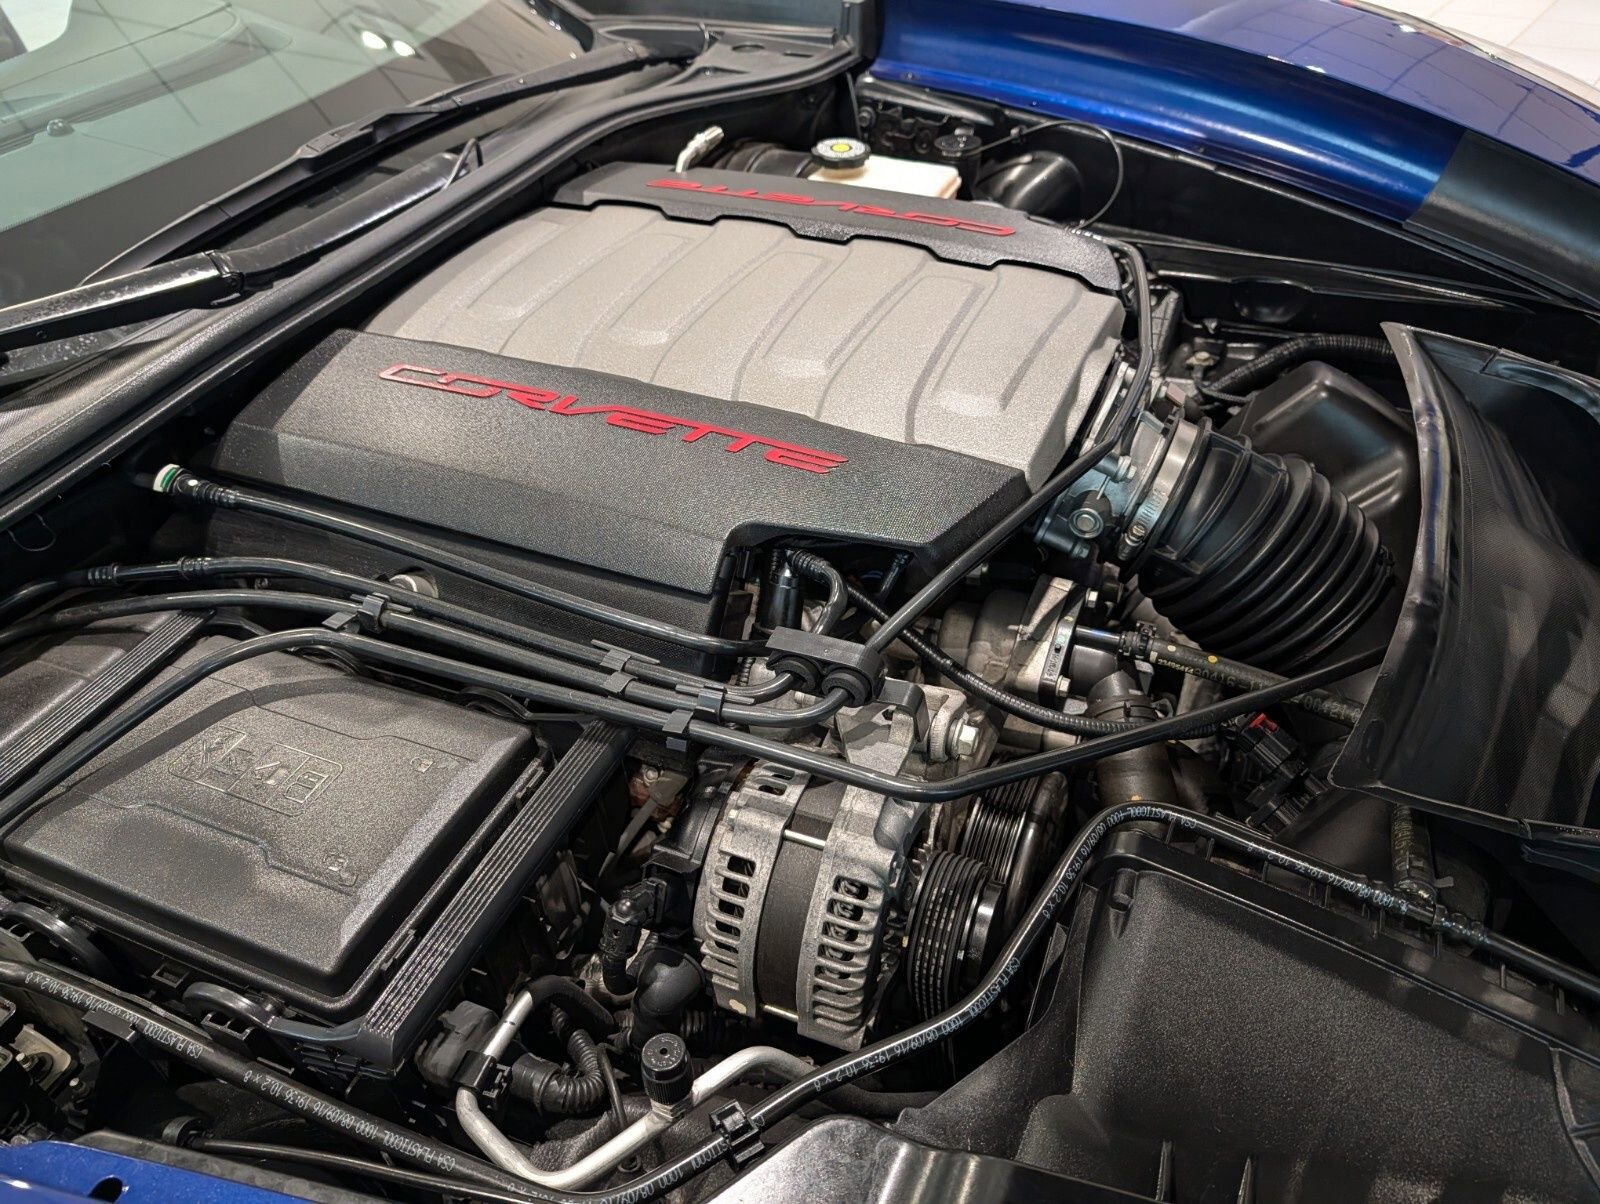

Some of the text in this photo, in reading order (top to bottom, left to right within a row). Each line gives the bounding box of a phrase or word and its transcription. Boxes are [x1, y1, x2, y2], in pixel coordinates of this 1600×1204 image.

[645, 178, 1016, 237] CORVETTE
[377, 363, 850, 474] CORVETTE
[285, 1090, 311, 1111] 19:36
[312, 1101, 354, 1130] 08/09/16
[355, 1120, 379, 1139] 1000
[383, 1131, 436, 1164] PLASTICOOL
[437, 1155, 456, 1171] CSA
